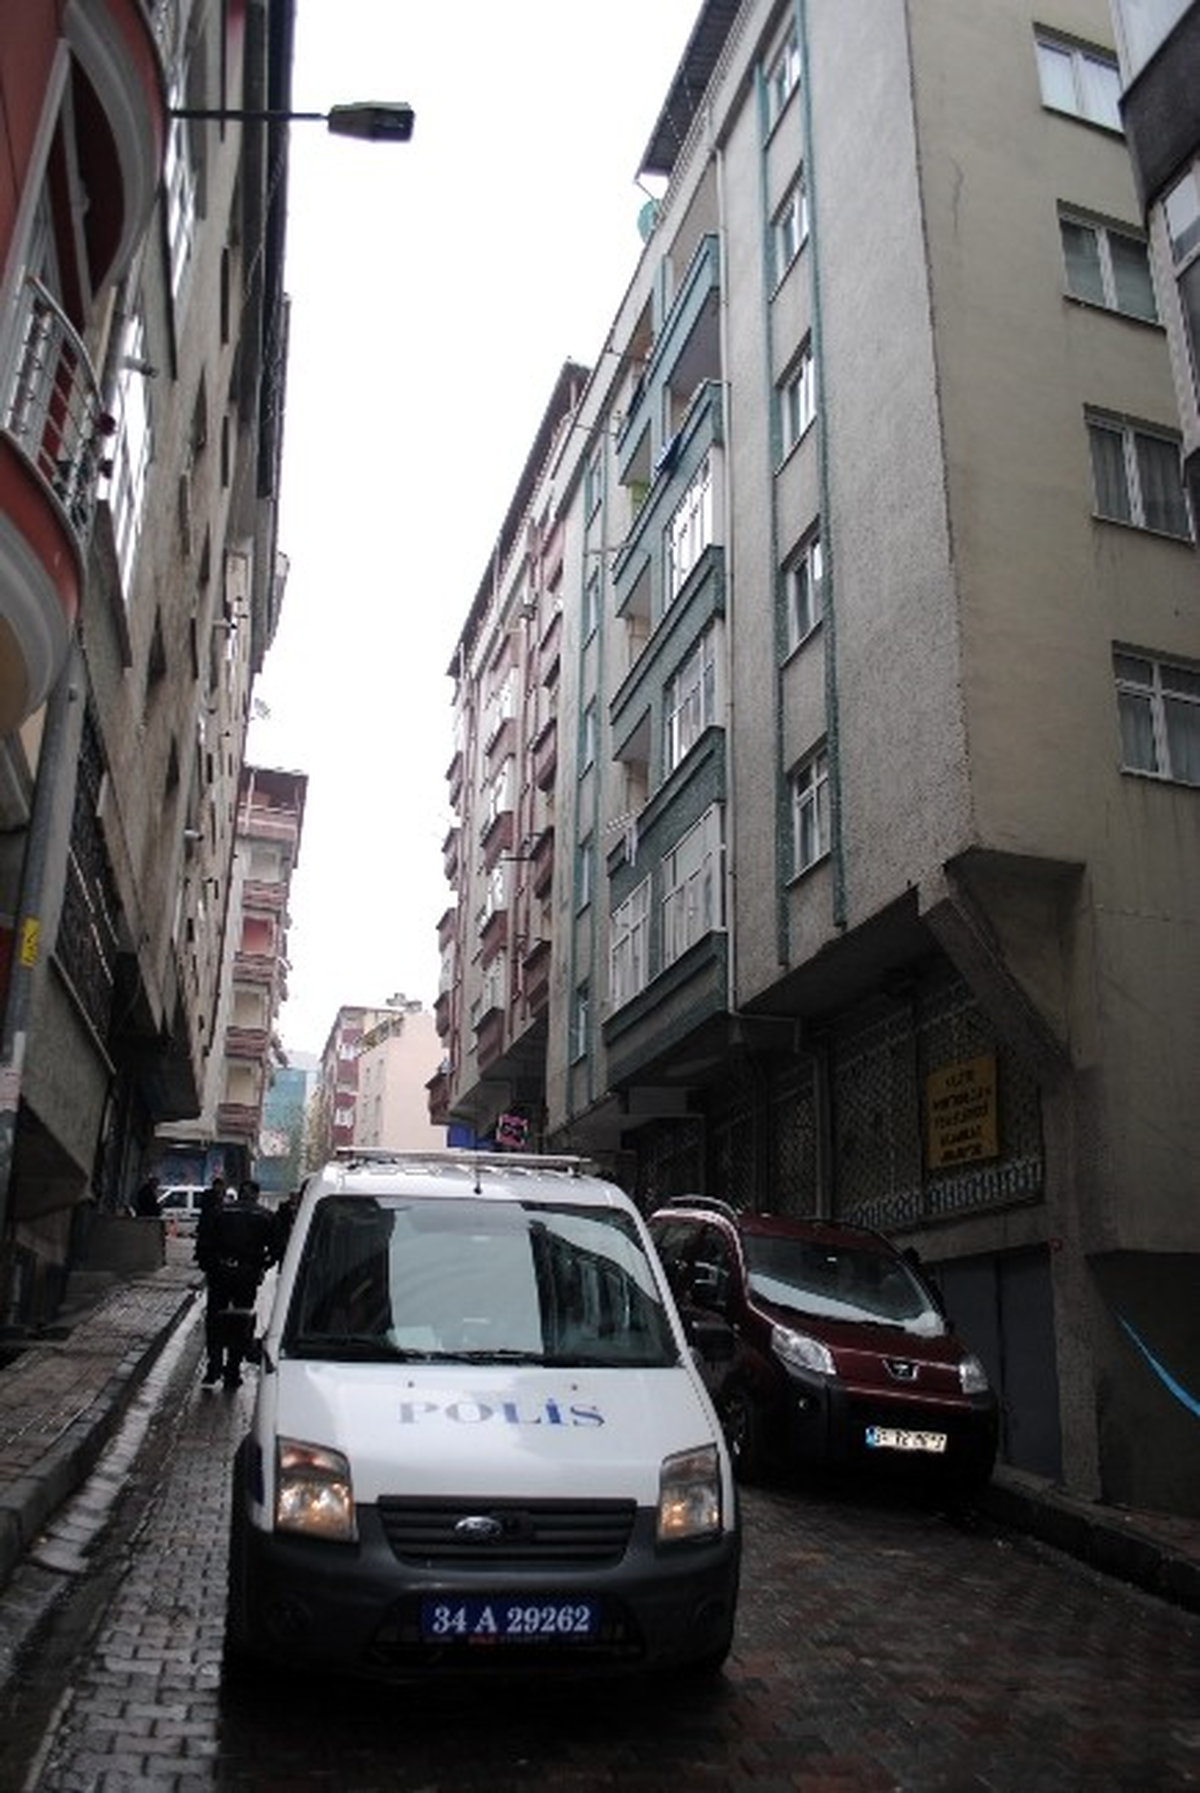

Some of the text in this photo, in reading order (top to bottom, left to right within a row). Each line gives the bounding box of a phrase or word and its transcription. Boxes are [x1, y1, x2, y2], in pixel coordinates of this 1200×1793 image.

[432, 1604, 591, 1634] 34 A 29262
